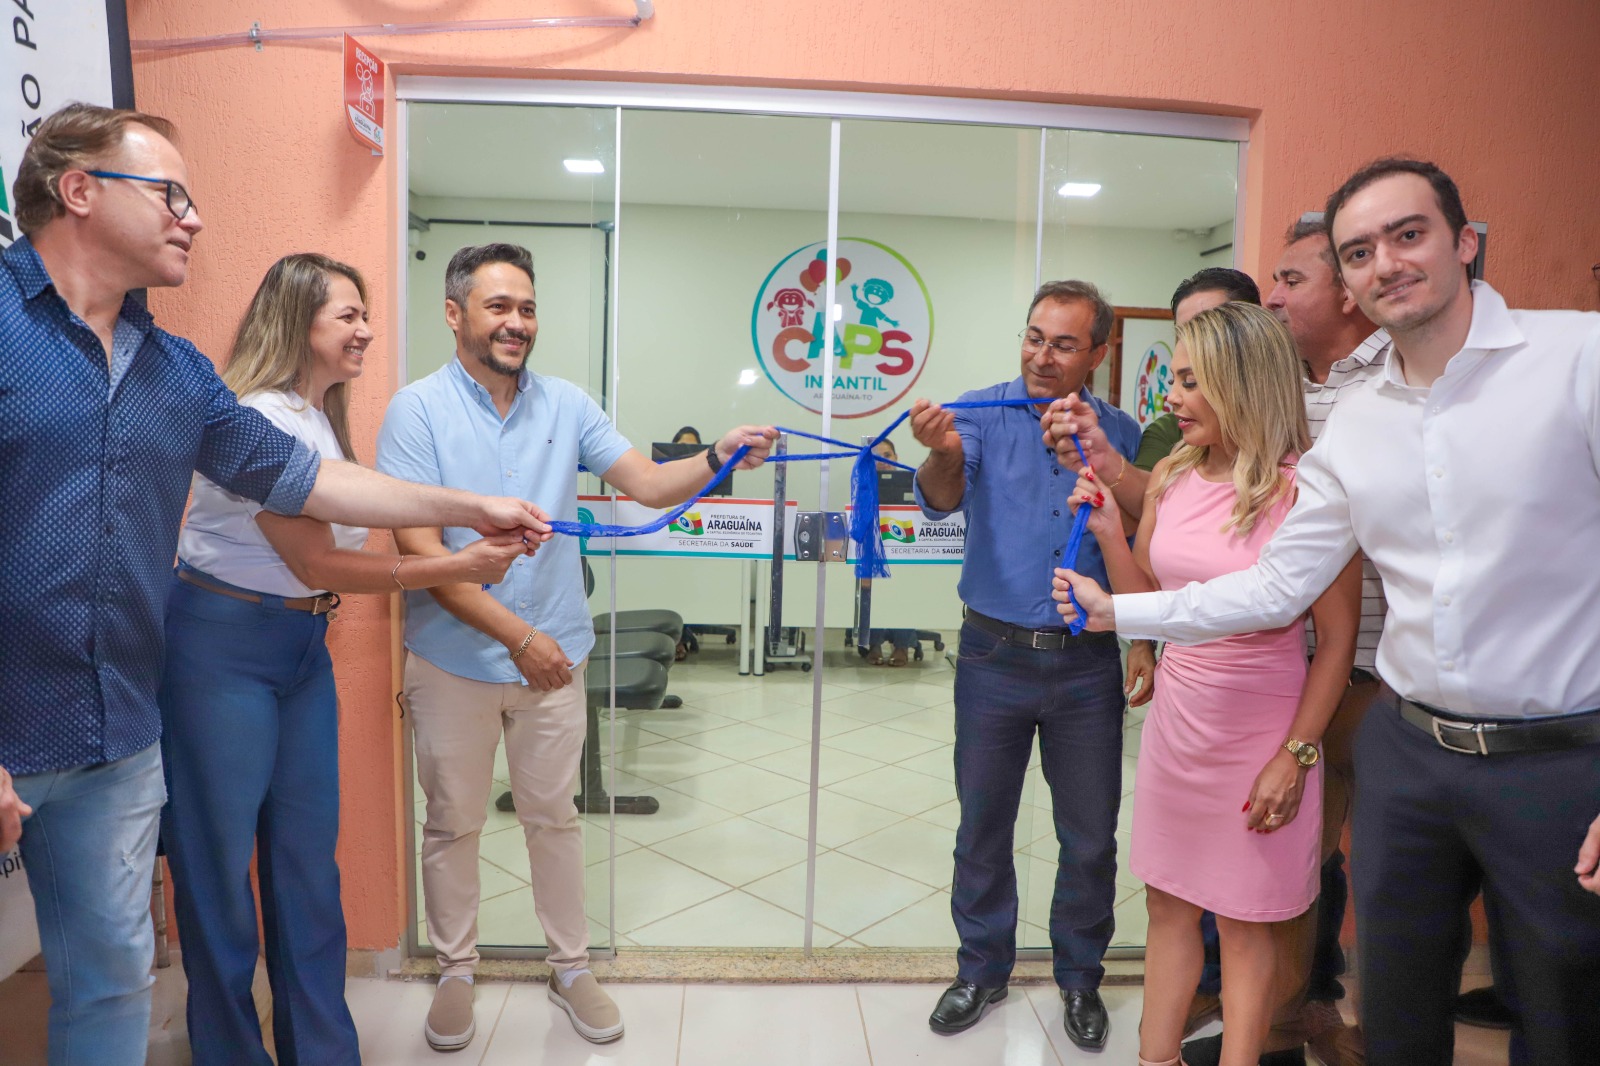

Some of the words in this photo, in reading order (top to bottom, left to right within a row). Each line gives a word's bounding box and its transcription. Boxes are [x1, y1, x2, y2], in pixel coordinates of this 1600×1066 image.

[772, 311, 914, 376] CAPS
[805, 374, 888, 391] INANTIL
[707, 519, 762, 531] ARAGUAÍNA
[919, 526, 965, 537] ARAGUAÍN
[678, 539, 718, 547] SECRETARIA
[730, 540, 754, 548] SAÚDE
